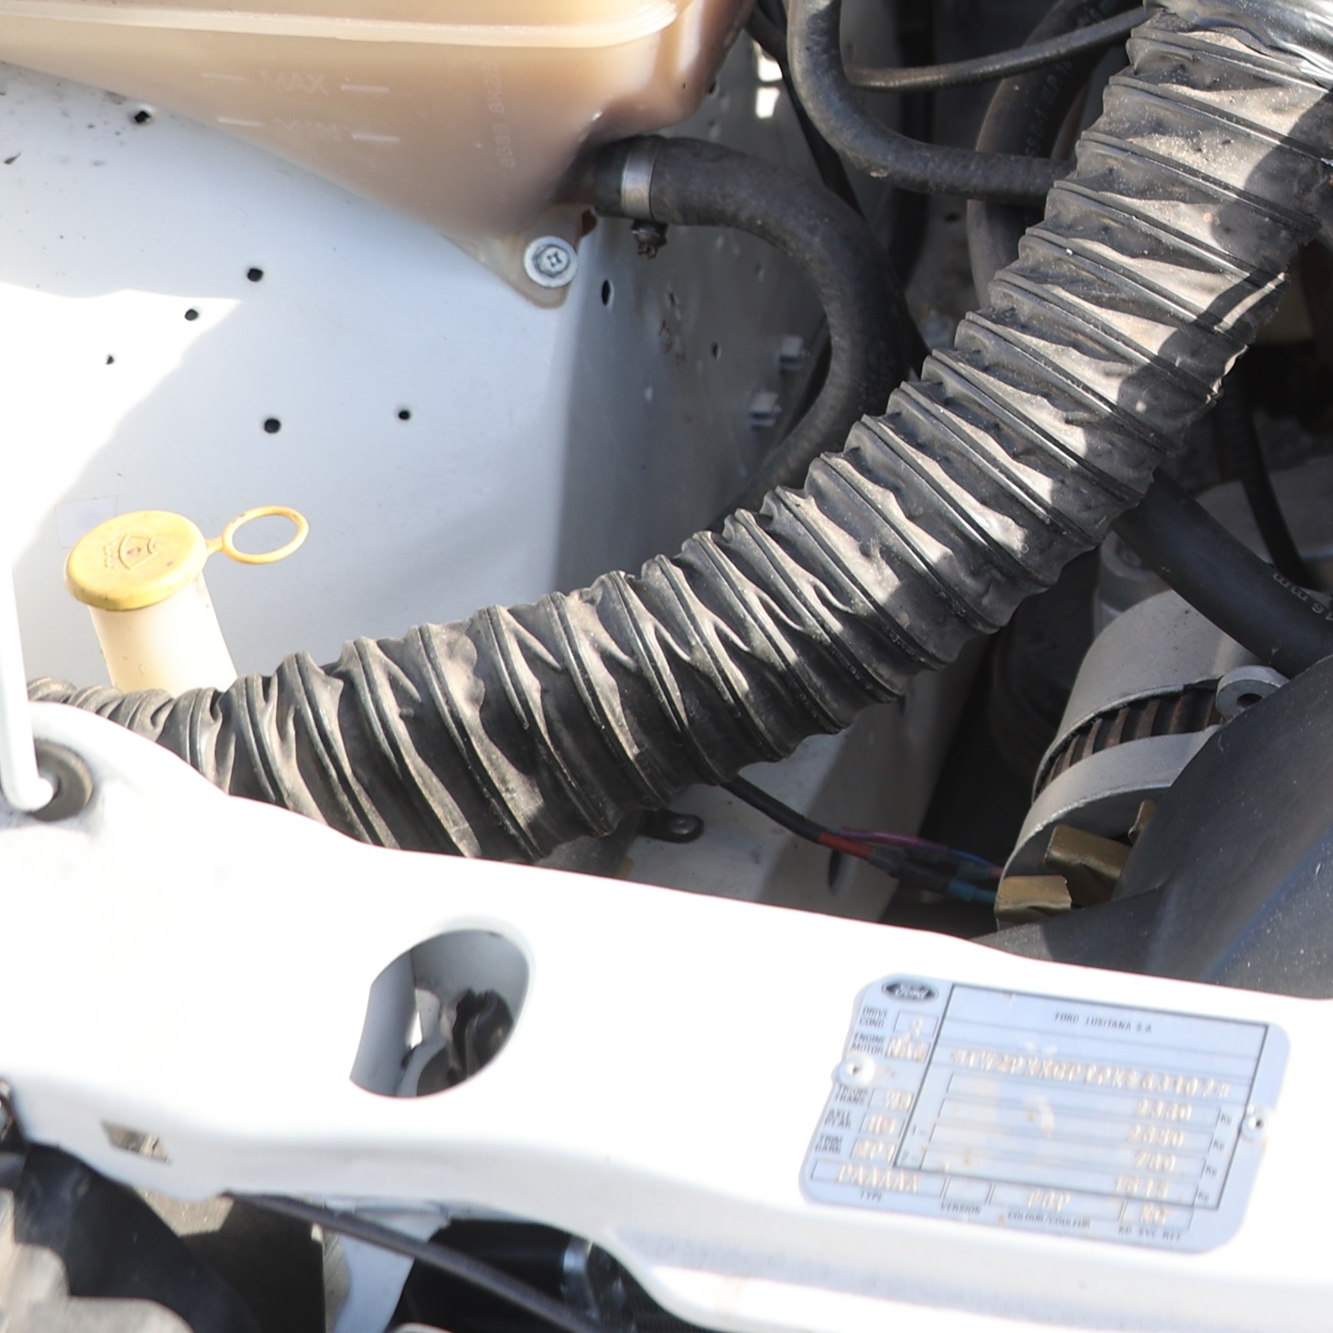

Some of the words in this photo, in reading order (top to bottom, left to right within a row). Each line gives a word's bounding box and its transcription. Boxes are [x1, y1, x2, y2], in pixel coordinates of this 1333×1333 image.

[1054, 1012, 1080, 1024] FORD
[1086, 1015, 1132, 1031] LUSITANA
[940, 1202, 983, 1215] VERSION
